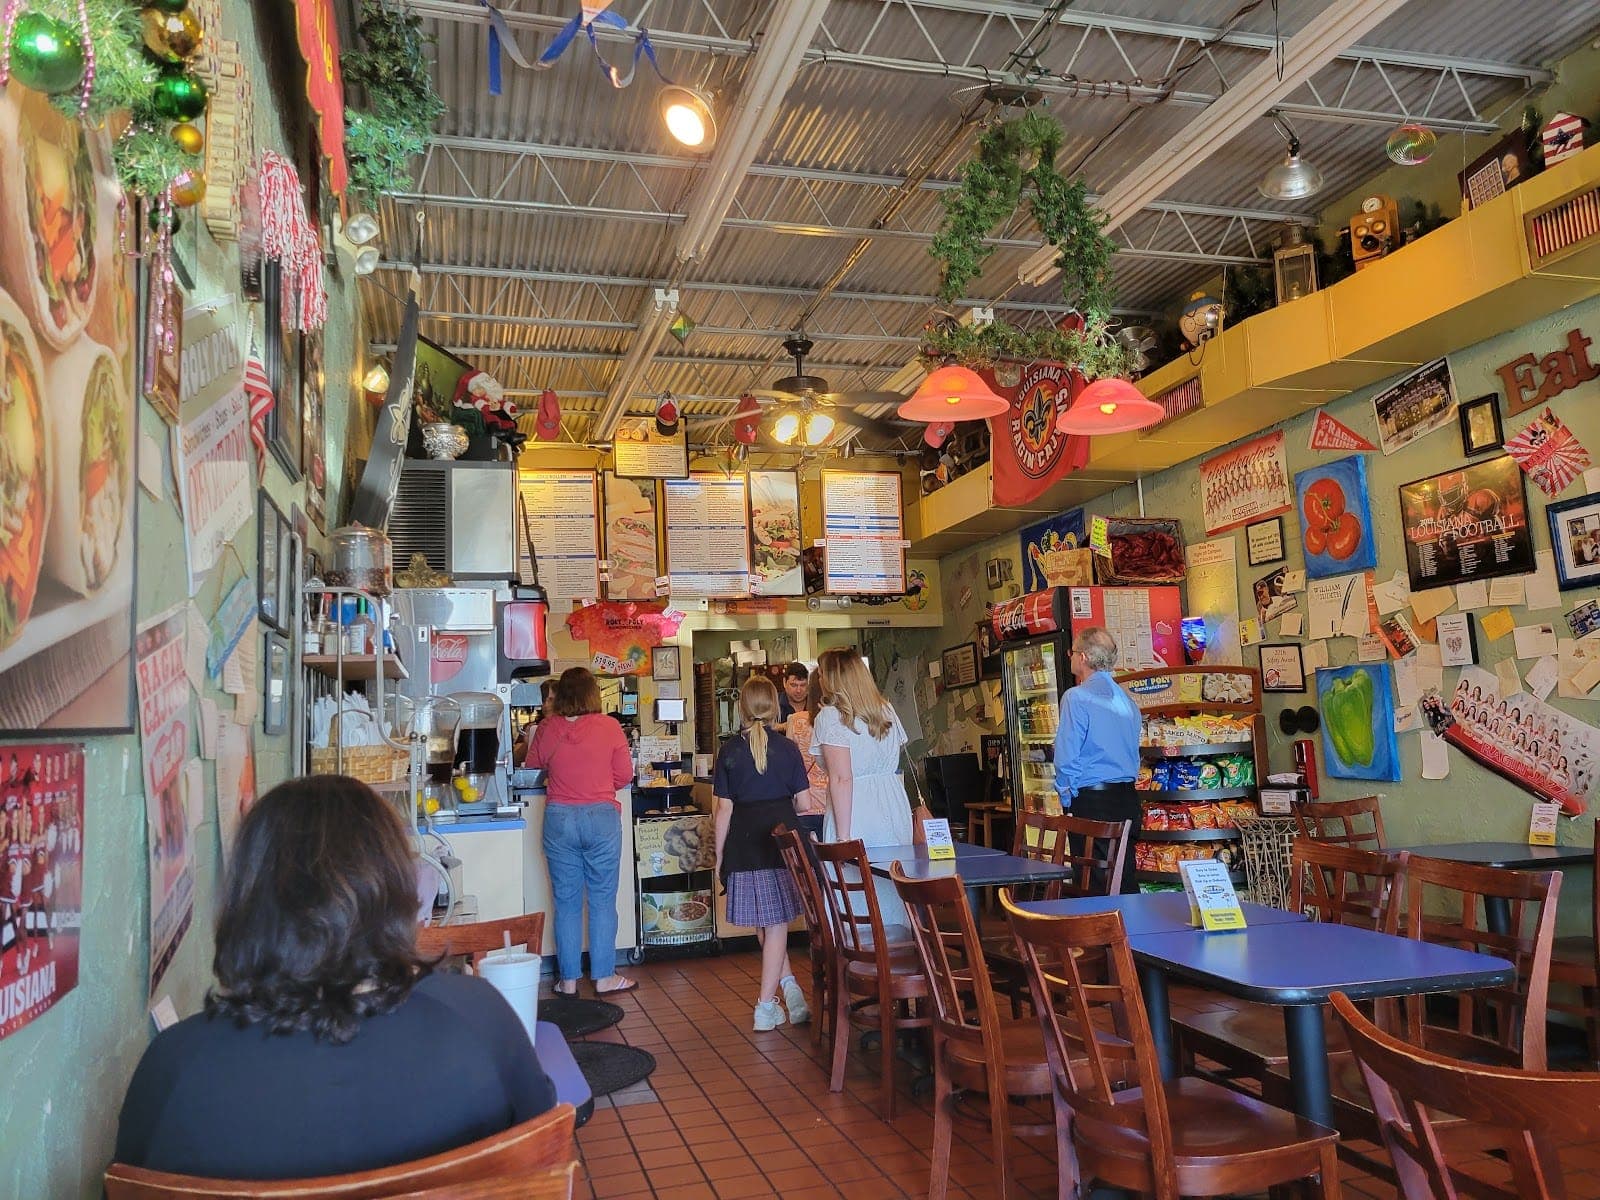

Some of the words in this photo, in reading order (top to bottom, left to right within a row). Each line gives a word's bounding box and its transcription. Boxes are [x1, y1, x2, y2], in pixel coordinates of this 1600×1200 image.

[1495, 328, 1600, 418] Eat
[1014, 366, 1062, 410] LOUISIANA
[1411, 515, 1472, 539] LOUISIANA
[1448, 514, 1519, 541] FOOTBALL
[594, 656, 616, 669] $19.95
[1150, 676, 1171, 685] POLY
